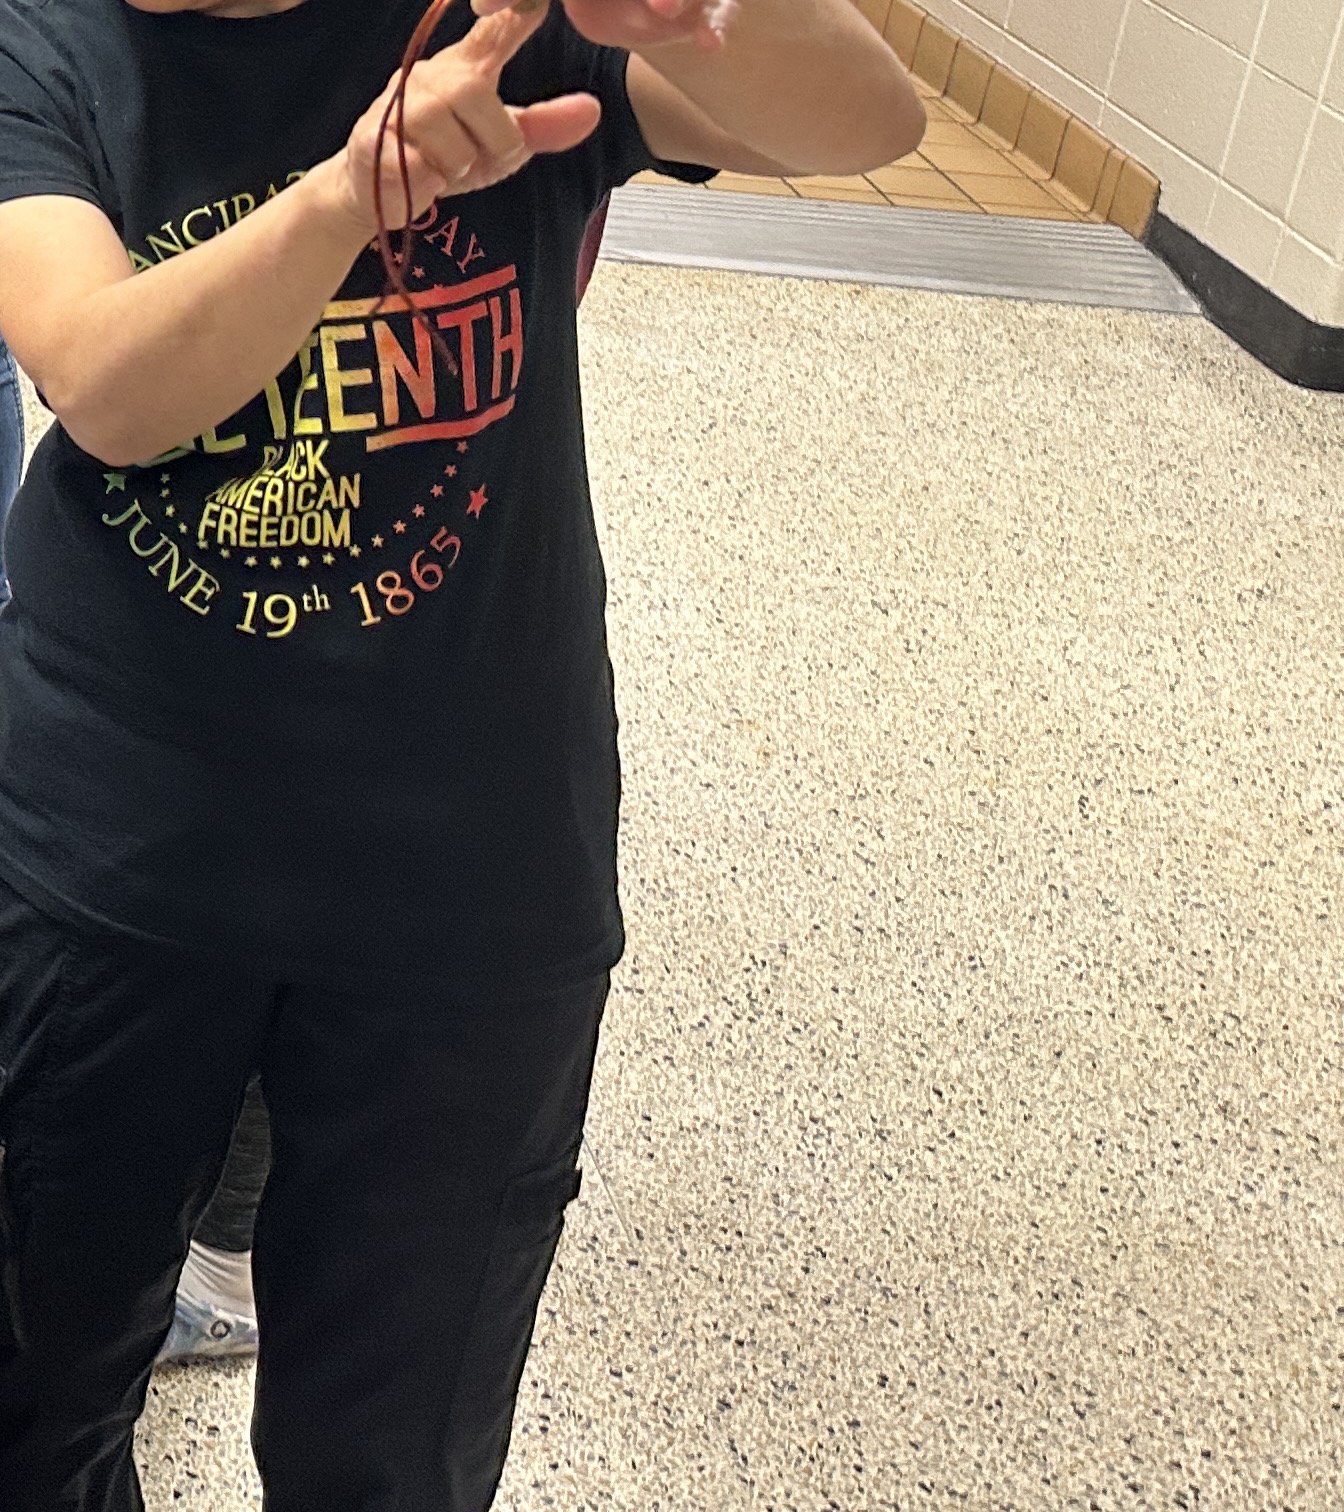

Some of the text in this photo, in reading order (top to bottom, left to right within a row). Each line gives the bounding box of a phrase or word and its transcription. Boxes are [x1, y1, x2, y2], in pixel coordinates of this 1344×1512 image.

[204, 472, 361, 517] AMERICAN
[197, 502, 352, 549] FREEDOM
[102, 498, 463, 639] JUNE 19th 1865
